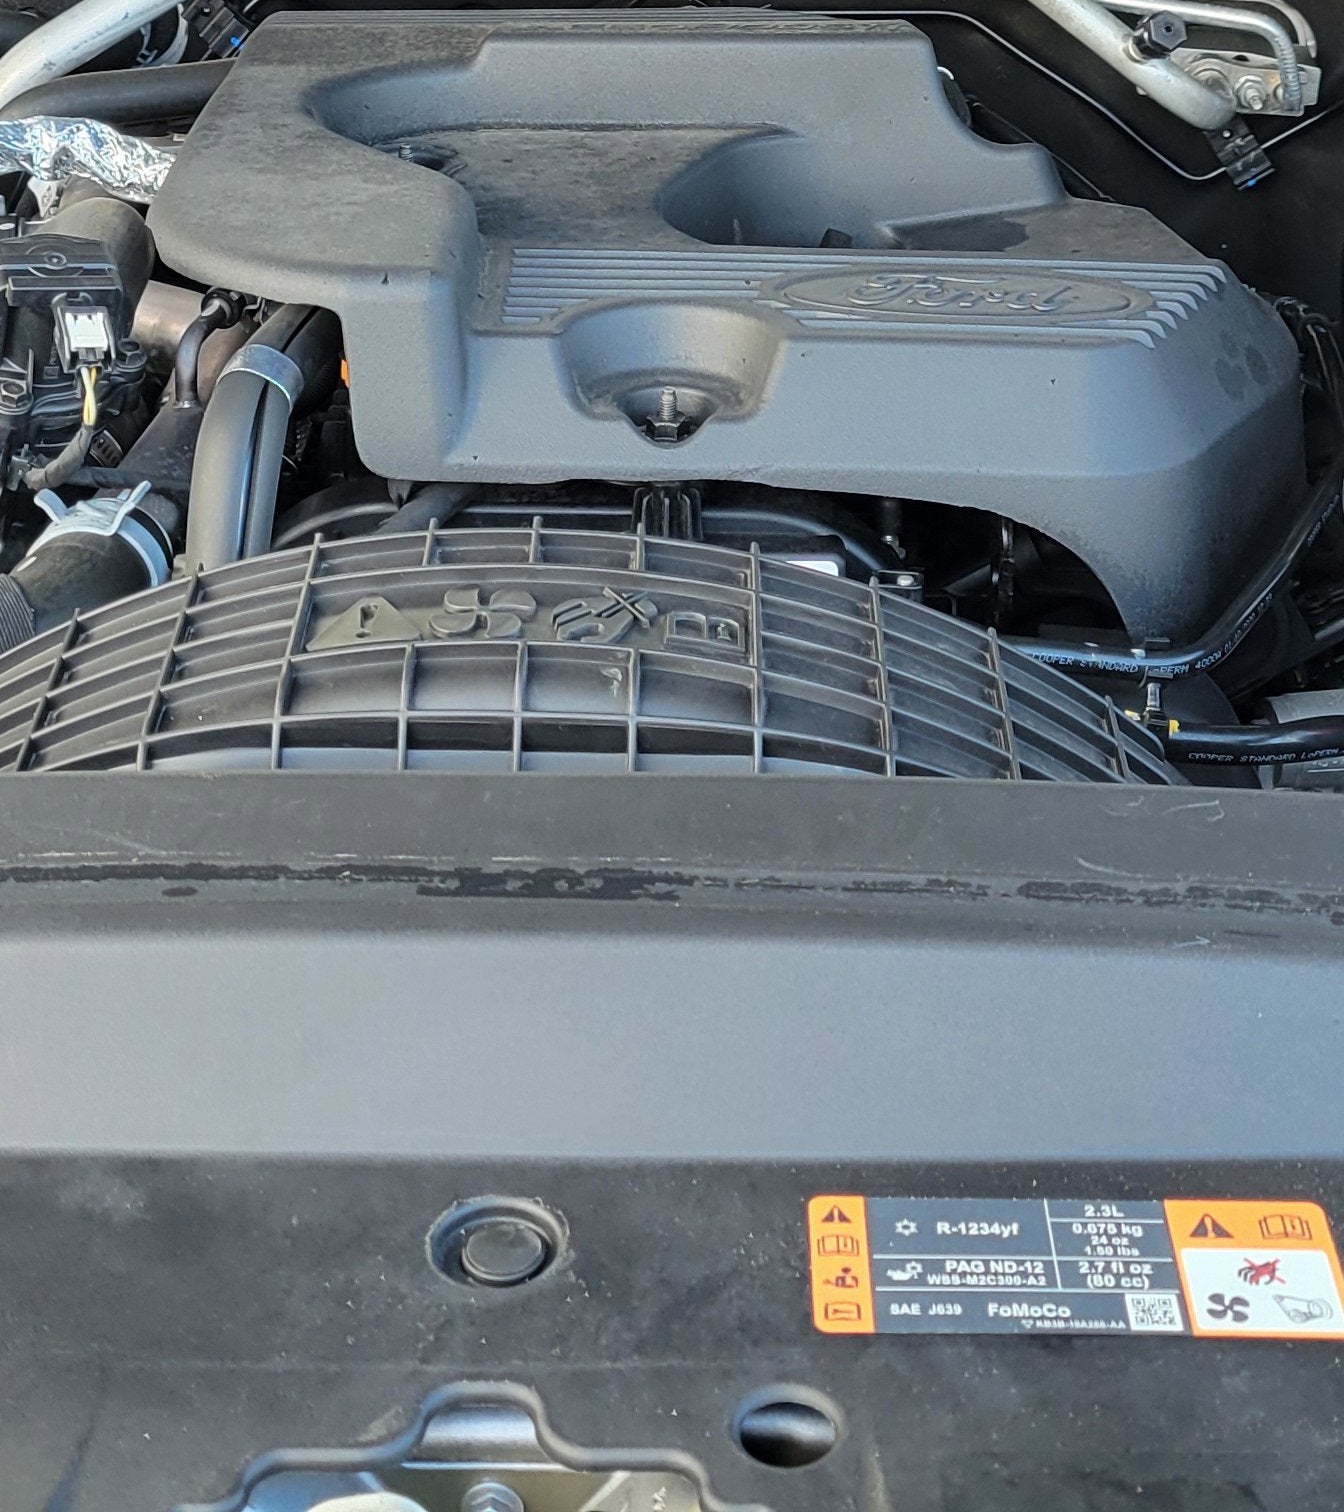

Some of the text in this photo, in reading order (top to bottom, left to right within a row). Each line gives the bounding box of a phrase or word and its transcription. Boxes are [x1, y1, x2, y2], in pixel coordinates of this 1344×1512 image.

[846, 272, 1074, 312] Ford
[1083, 1203, 1125, 1218] 2.3L
[936, 1221, 1020, 1238] R-1234yf
[1121, 1222, 1144, 1238] kg
[1090, 1234, 1130, 1246] 24 oz
[1116, 1245, 1141, 1257] lbs
[945, 1259, 1045, 1275] PAG ND-12
[1078, 1261, 1155, 1275] 2.7 fl oz
[1120, 1274, 1150, 1290] cc)
[889, 1302, 922, 1316] SAE
[987, 1301, 1072, 1318] FoMoCo
